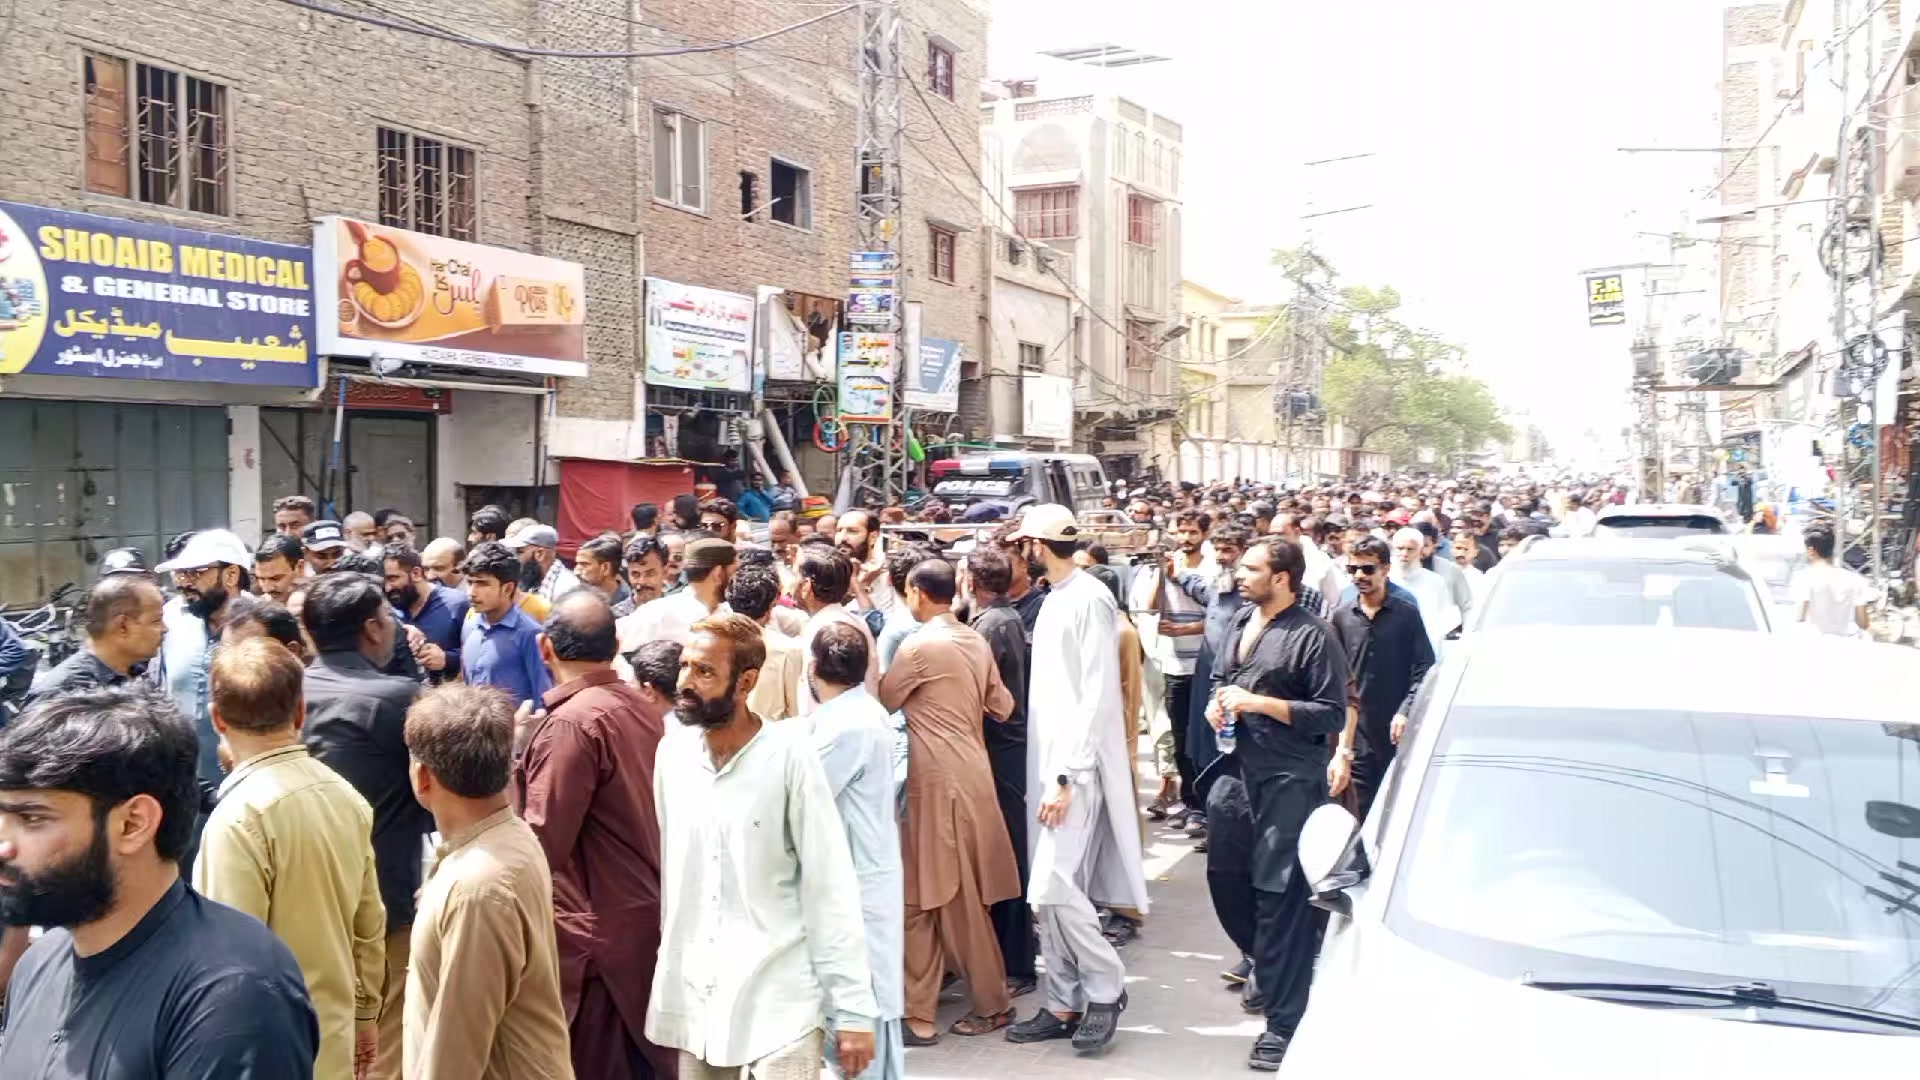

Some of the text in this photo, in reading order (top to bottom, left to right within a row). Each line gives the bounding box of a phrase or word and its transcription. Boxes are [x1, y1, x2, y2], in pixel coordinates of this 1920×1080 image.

[38, 225, 309, 291] SHOAIB MEDICAL
[61, 275, 311, 317] & GENERAL STORE
[53, 307, 163, 341] میڈیکل
[936, 480, 1011, 491] POLICE
